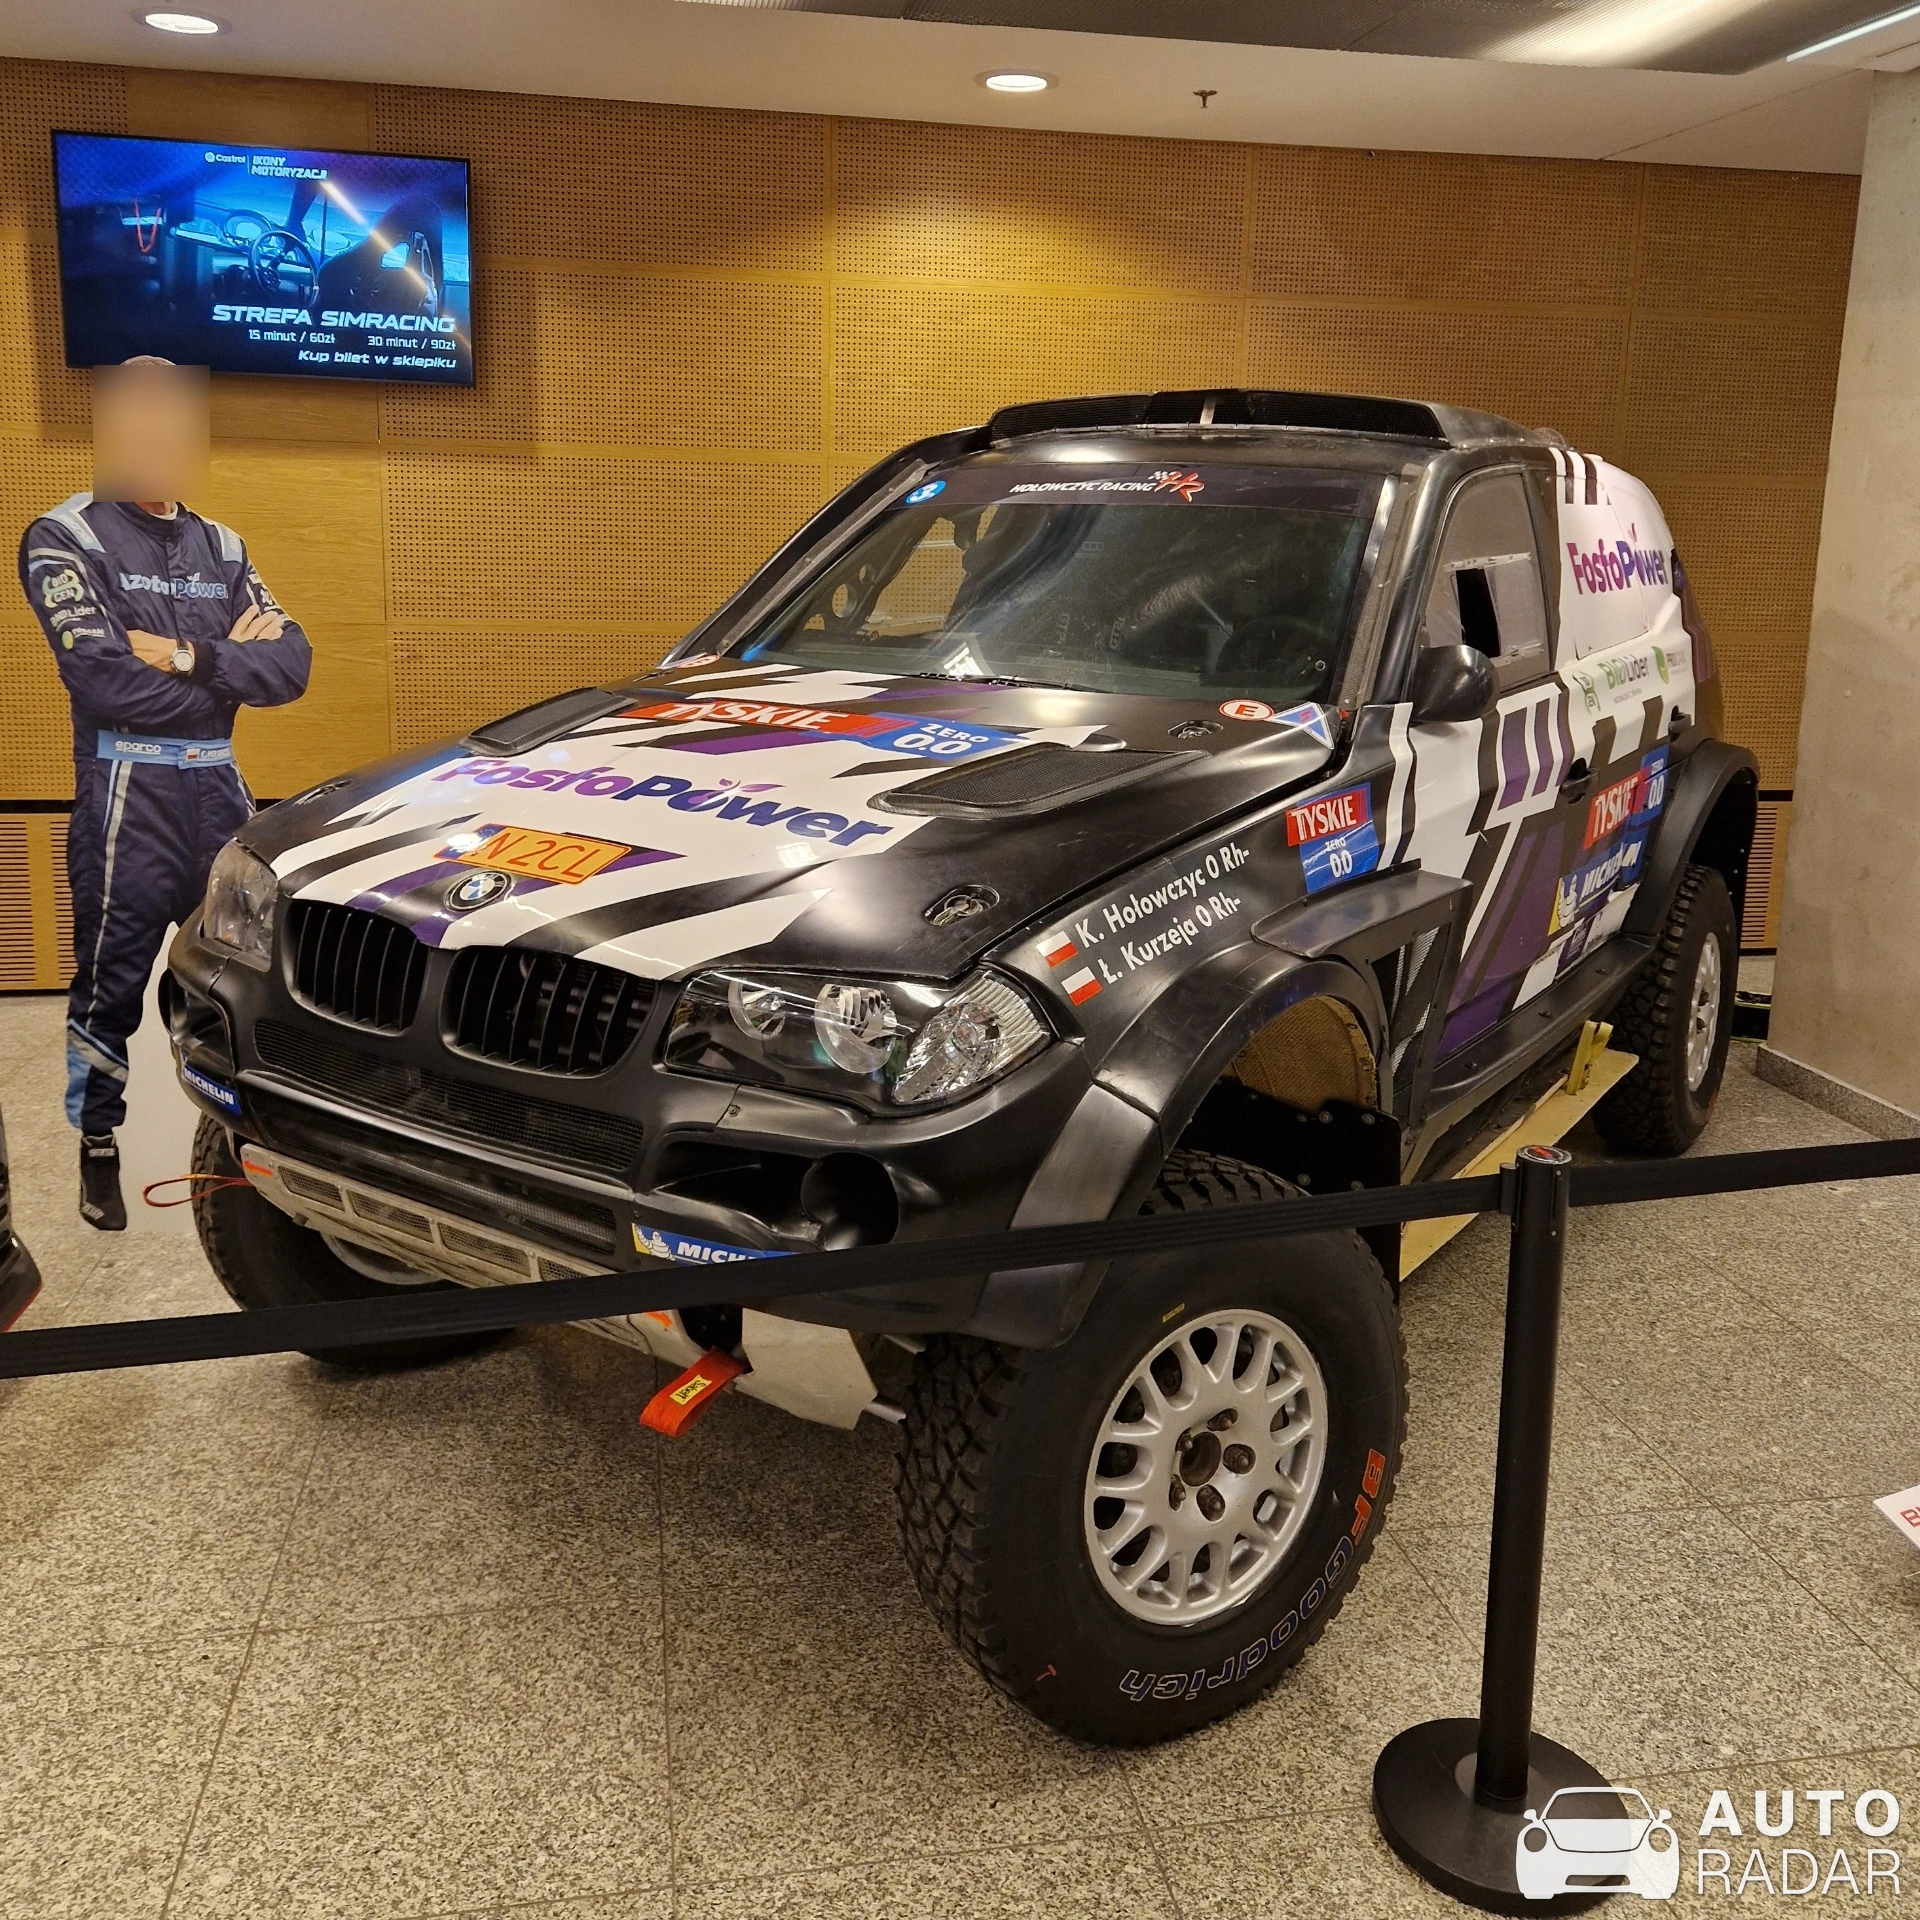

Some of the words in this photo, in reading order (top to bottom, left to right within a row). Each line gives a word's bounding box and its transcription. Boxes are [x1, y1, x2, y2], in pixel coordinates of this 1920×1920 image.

[215, 154, 246, 164] Castrol
[253, 155, 286, 167] IKONY
[212, 304, 312, 325] STREFA
[320, 310, 455, 333] SIMRACING
[249, 329, 261, 340] 15
[263, 330, 297, 342] minut
[309, 332, 335, 344] 60zł
[367, 335, 382, 347] 30
[386, 337, 418, 349] minut
[431, 339, 456, 350] 90zł
[298, 350, 329, 363] Kup
[334, 352, 370, 365] bilet
[374, 355, 389, 365] w
[392, 354, 456, 368] sklepiku
[1099, 482, 1155, 492] RACING
[1566, 538, 1669, 596] FosfoPower
[653, 702, 849, 730] TYSKIE
[1235, 704, 1259, 717] E
[893, 733, 973, 755] 0.0
[920, 723, 989, 743] ZERO
[430, 759, 896, 847] FosfoPower
[1593, 776, 1639, 839] TYSKIE
[1291, 795, 1357, 841] TYSKIE
[1325, 837, 1347, 851] ZERO
[506, 839, 601, 878] 2CL
[1330, 849, 1353, 878] 0.0
[1075, 918, 1105, 949] K.
[1103, 868, 1207, 933] Hołowczyc
[1219, 842, 1250, 872] Rh-
[1098, 958, 1123, 985] Ł.
[1120, 916, 1199, 971] Kurzeja
[1207, 891, 1241, 921] Rh-
[184, 1067, 235, 1106] MICHELIN
[677, 1241, 757, 1264] MICH
